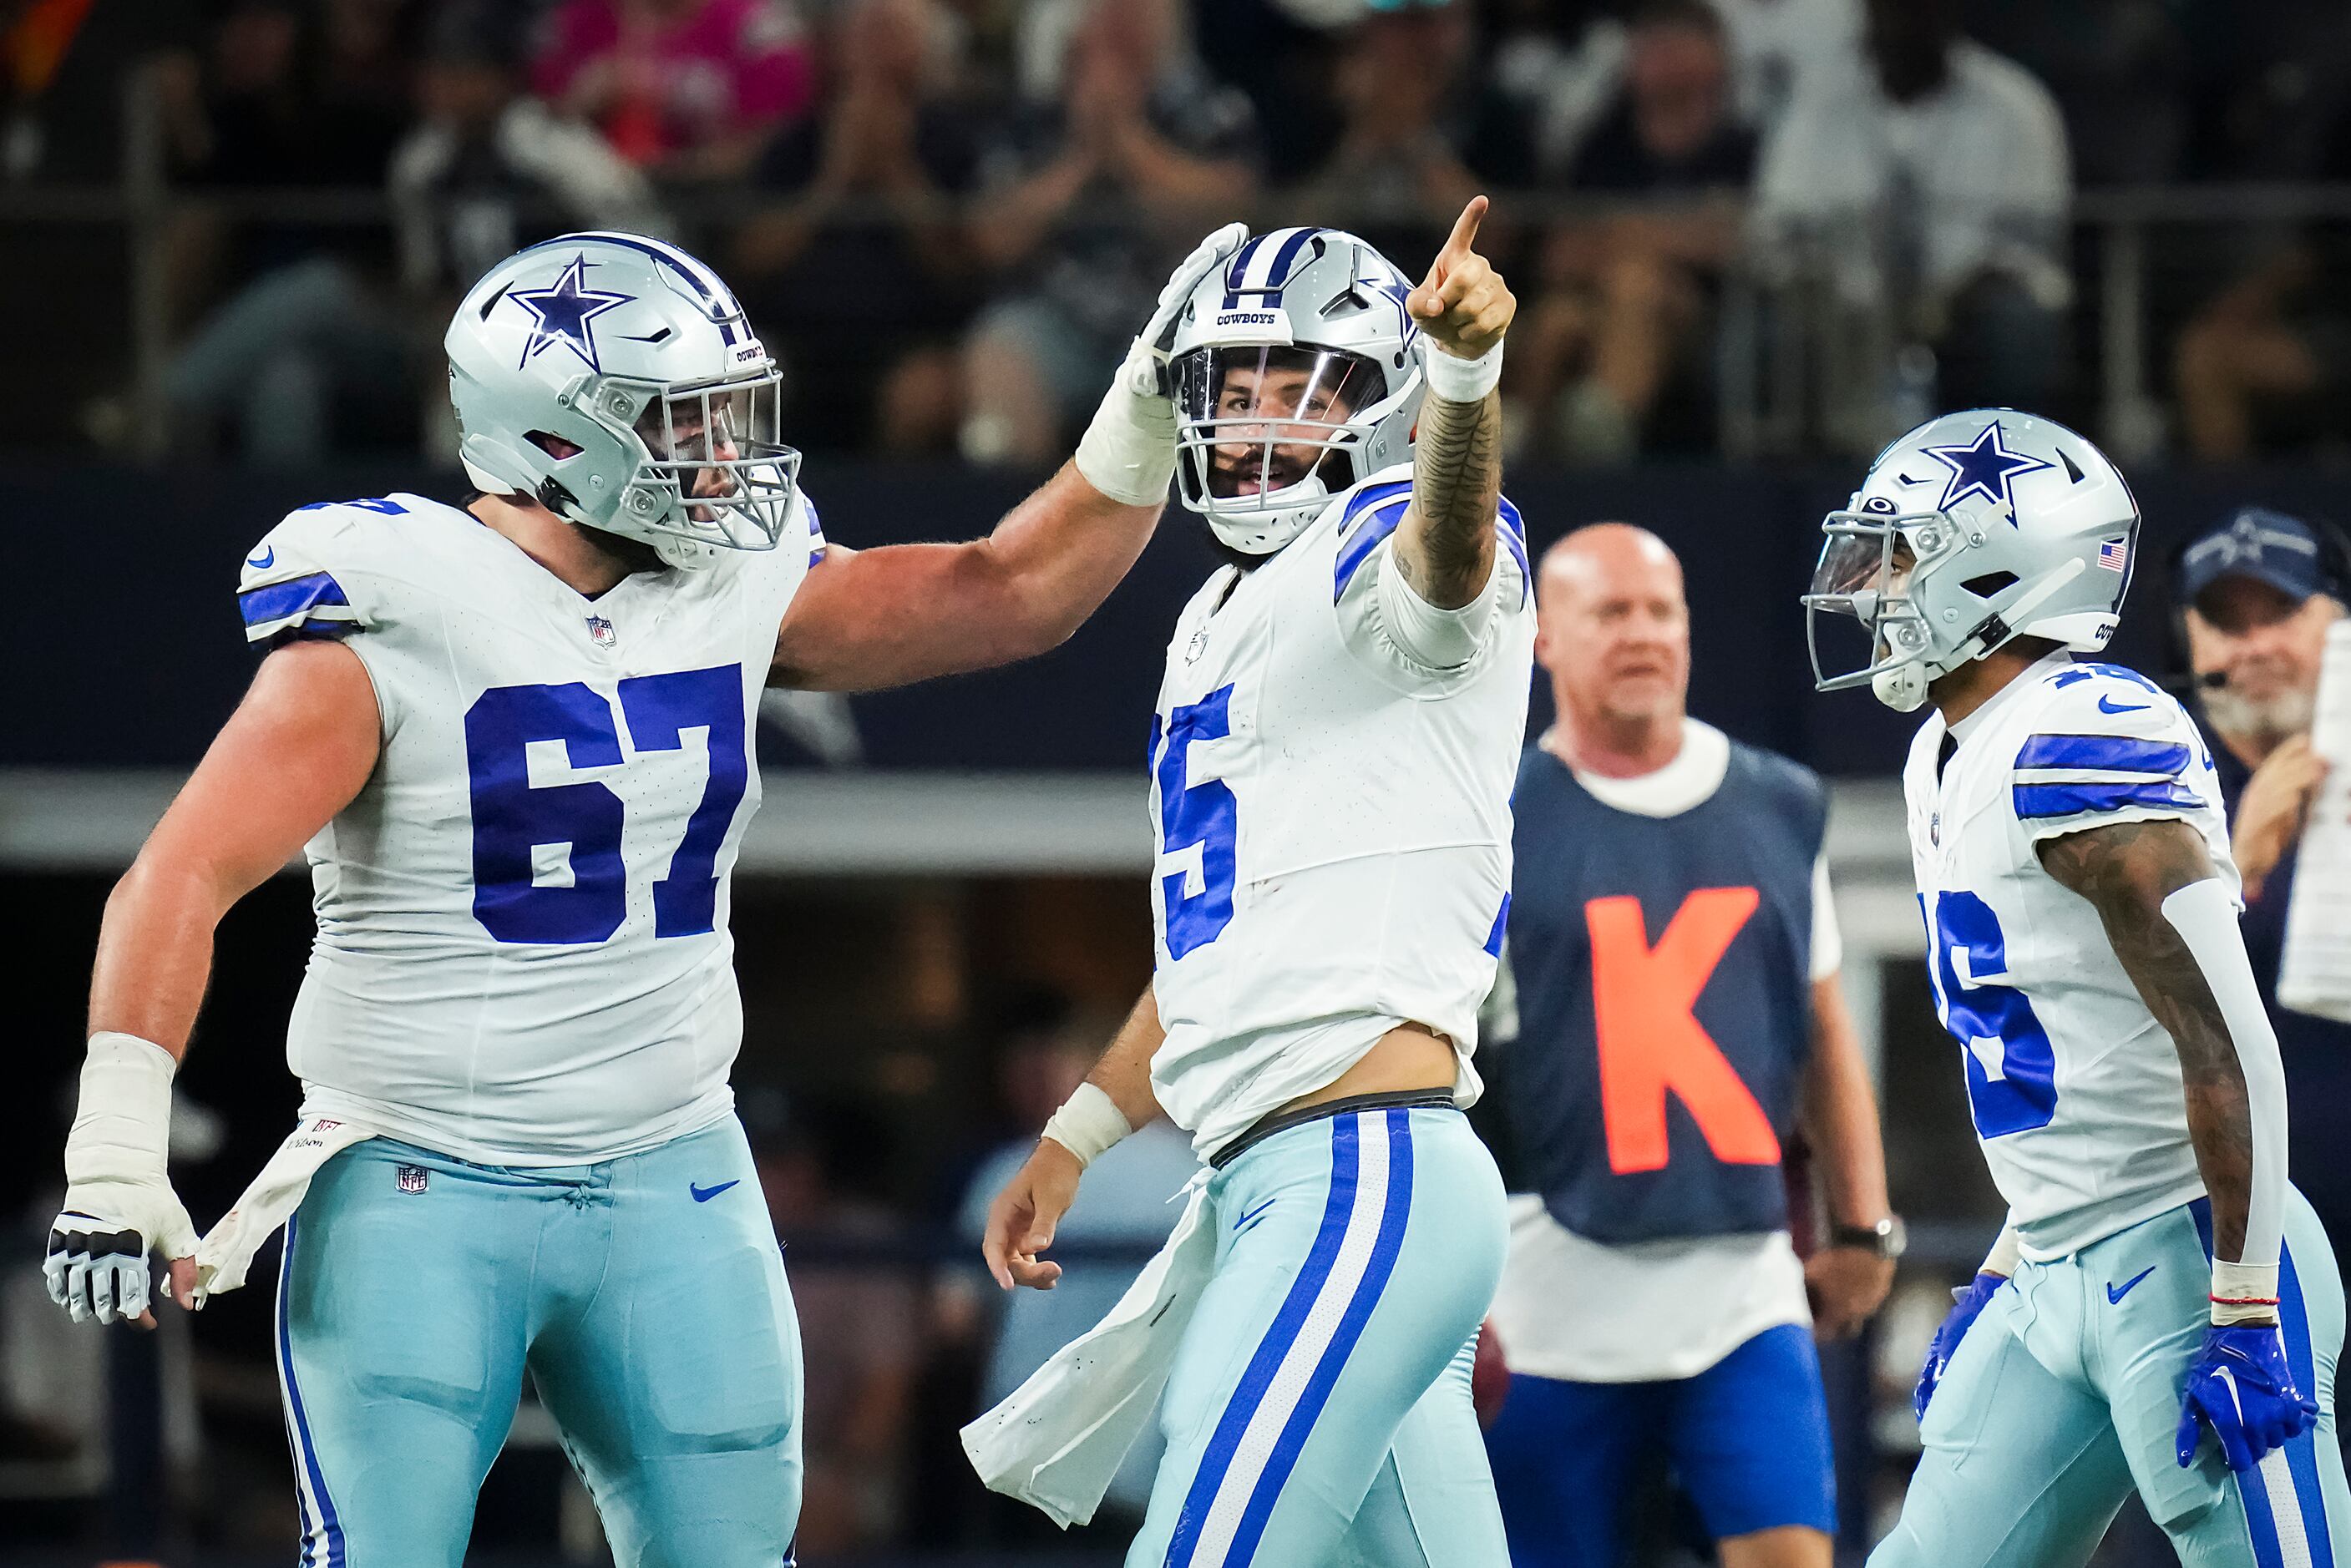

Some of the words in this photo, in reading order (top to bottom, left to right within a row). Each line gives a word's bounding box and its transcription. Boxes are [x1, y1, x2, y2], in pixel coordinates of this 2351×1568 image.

[1217, 313, 1275, 326] COWBOYS
[464, 662, 747, 945] 67
[1584, 886, 1781, 1175] K
[402, 1175, 425, 1190] NFL
